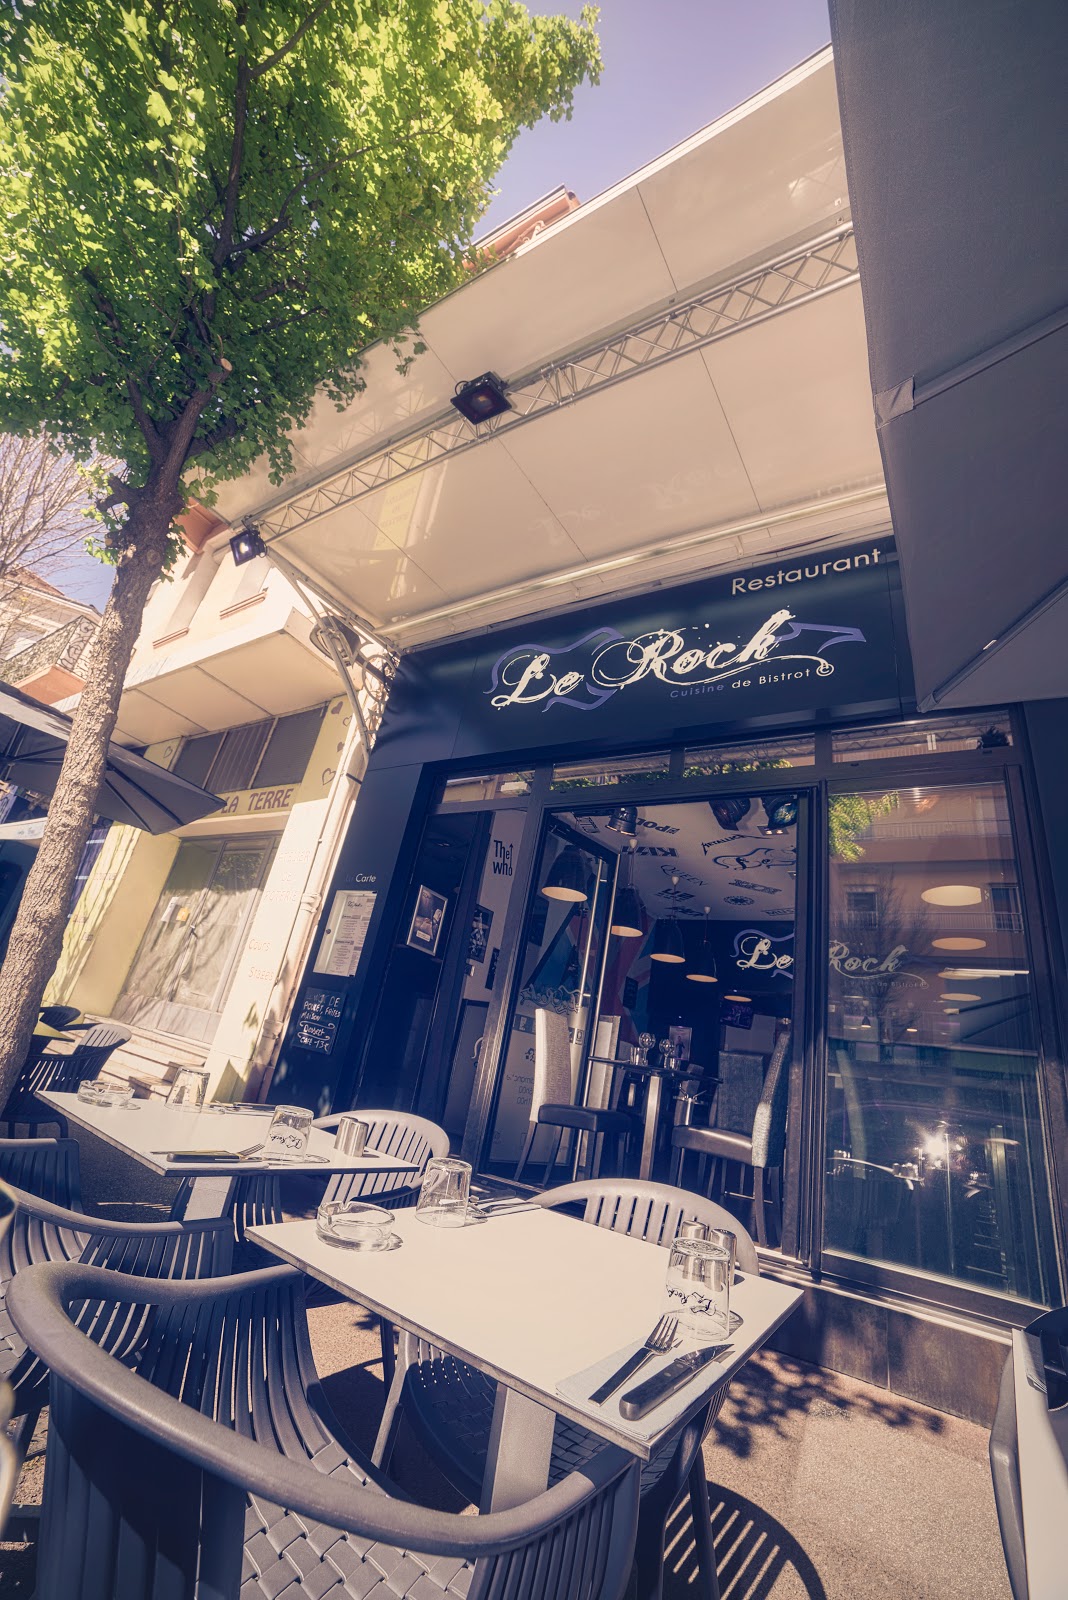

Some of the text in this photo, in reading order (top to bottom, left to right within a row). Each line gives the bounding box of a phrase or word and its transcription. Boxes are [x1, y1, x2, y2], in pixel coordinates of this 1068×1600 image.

[731, 548, 881, 595] Restaurant
[491, 609, 834, 711] Le Rock
[670, 669, 811, 698] Cuisine de Bistrot
[248, 788, 294, 811] TERRE
[494, 840, 512, 861] The
[355, 873, 376, 883] Carte
